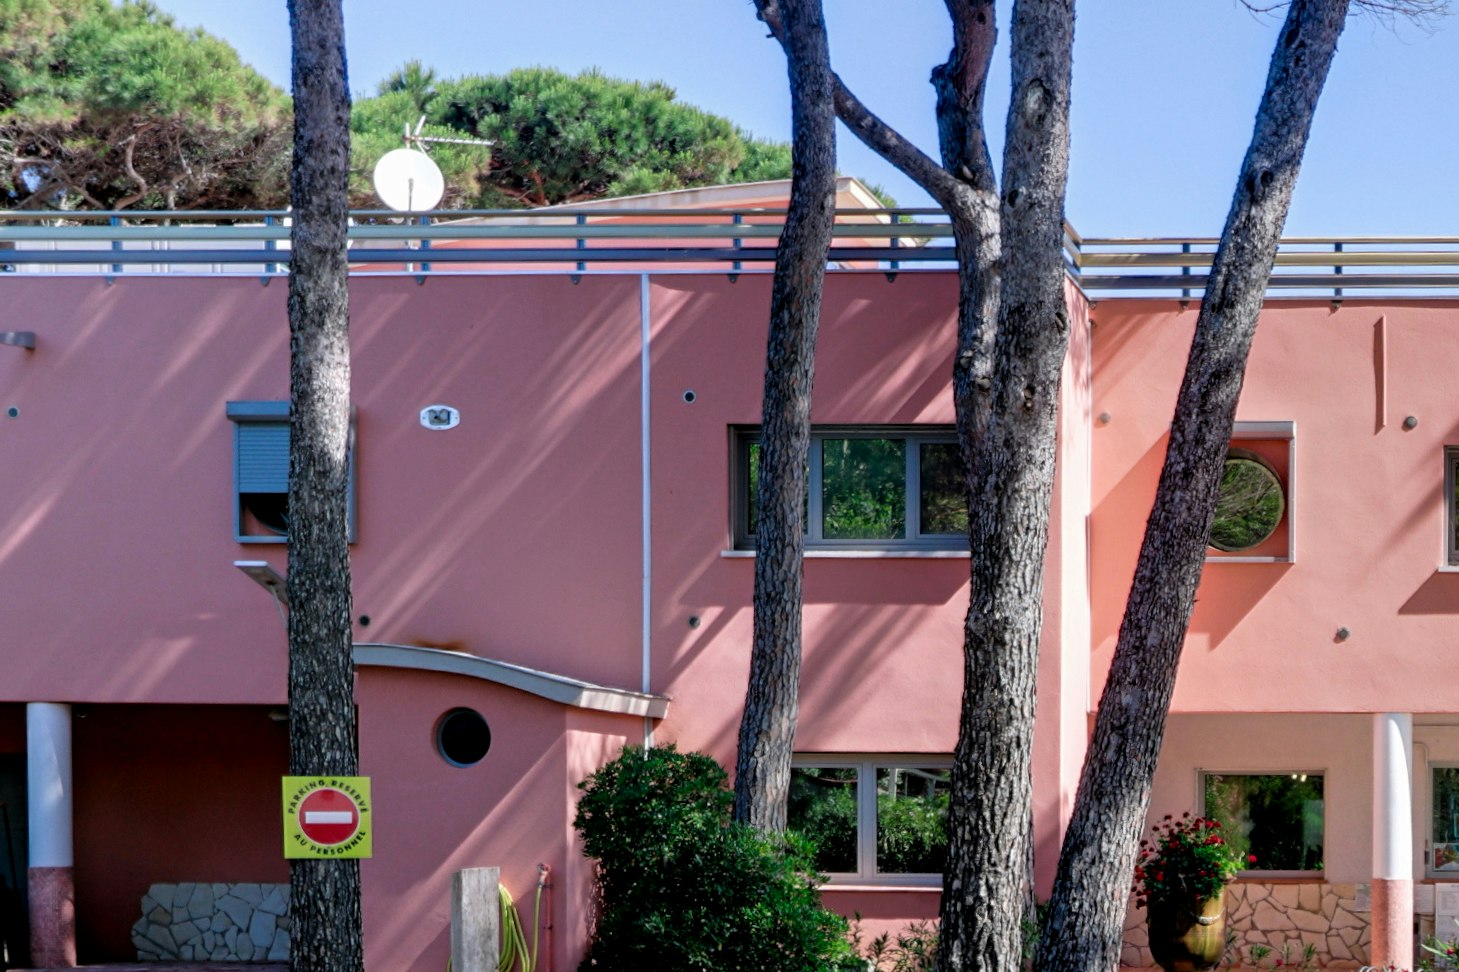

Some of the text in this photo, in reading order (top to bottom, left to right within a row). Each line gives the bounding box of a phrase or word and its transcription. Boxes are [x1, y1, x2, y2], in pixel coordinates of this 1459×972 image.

[287, 780, 325, 814] PARKING
[294, 831, 366, 855] AU PERSONNEL
